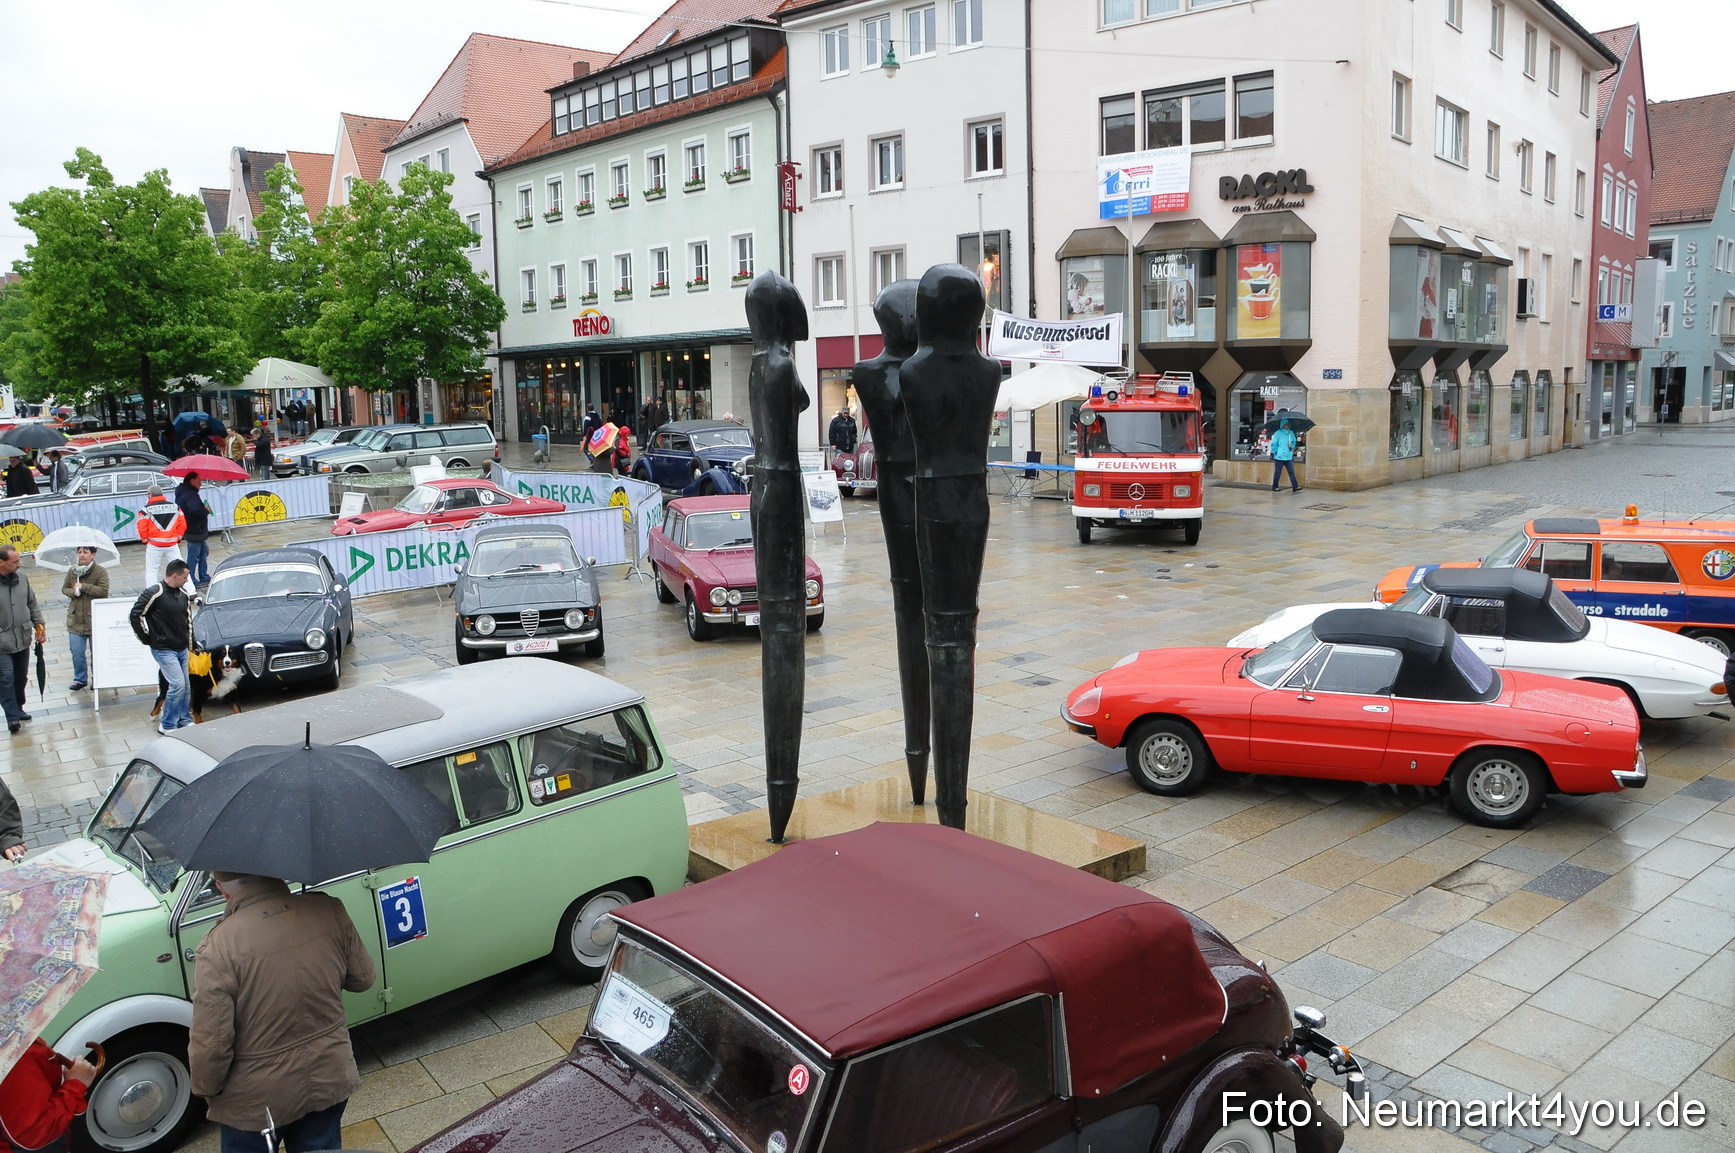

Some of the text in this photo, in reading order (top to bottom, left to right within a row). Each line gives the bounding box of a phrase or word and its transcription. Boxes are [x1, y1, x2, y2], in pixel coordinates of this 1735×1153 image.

[784, 171, 793, 207] Achatz
[1219, 168, 1314, 200] RACKL
[1232, 197, 1305, 213] am Rathaus
[1165, 253, 1183, 263] Jahre
[1152, 263, 1178, 279] RACKL
[1682, 241, 1697, 329] satzke
[572, 315, 610, 338] RENO
[1002, 320, 1111, 342] Museumsinsel
[1260, 386, 1280, 396] RACKL
[1097, 461, 1177, 470] FEUERWEHR
[540, 484, 595, 505] DEKRA
[386, 539, 471, 572] DEKRA
[1614, 603, 1669, 617] stradale
[380, 883, 419, 901] Die Blaue Nacht
[395, 897, 413, 932] 3
[632, 1006, 656, 1029] 465
